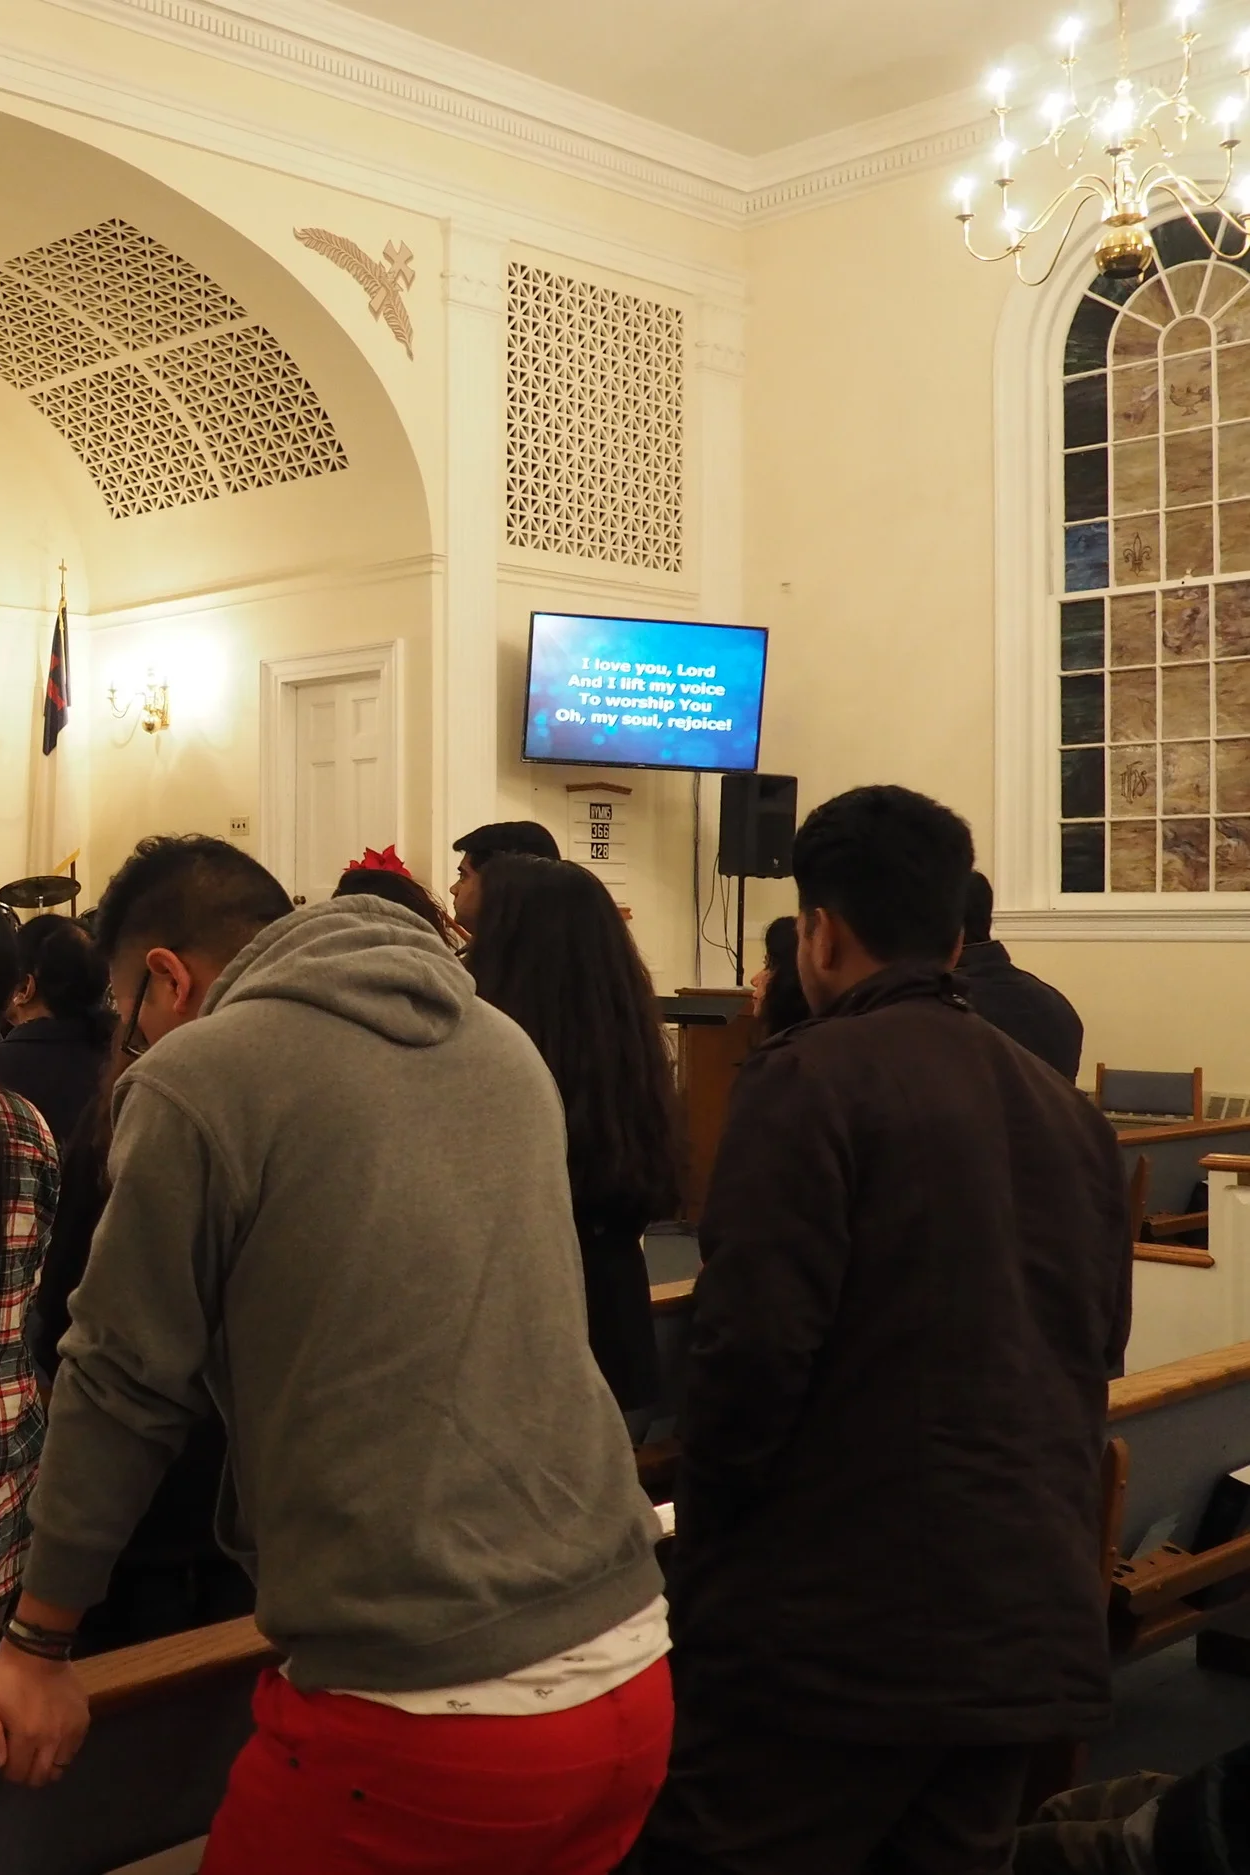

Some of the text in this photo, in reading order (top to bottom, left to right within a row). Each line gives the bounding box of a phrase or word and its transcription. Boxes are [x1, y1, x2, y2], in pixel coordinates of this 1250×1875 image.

[581, 657, 717, 679] I love you, Lord
[567, 674, 726, 697] And I lift my voice
[578, 692, 713, 713] To worship You
[555, 708, 733, 732] Oh, my soul, rejoice!
[592, 824, 610, 838] 366
[591, 844, 609, 858] 428
